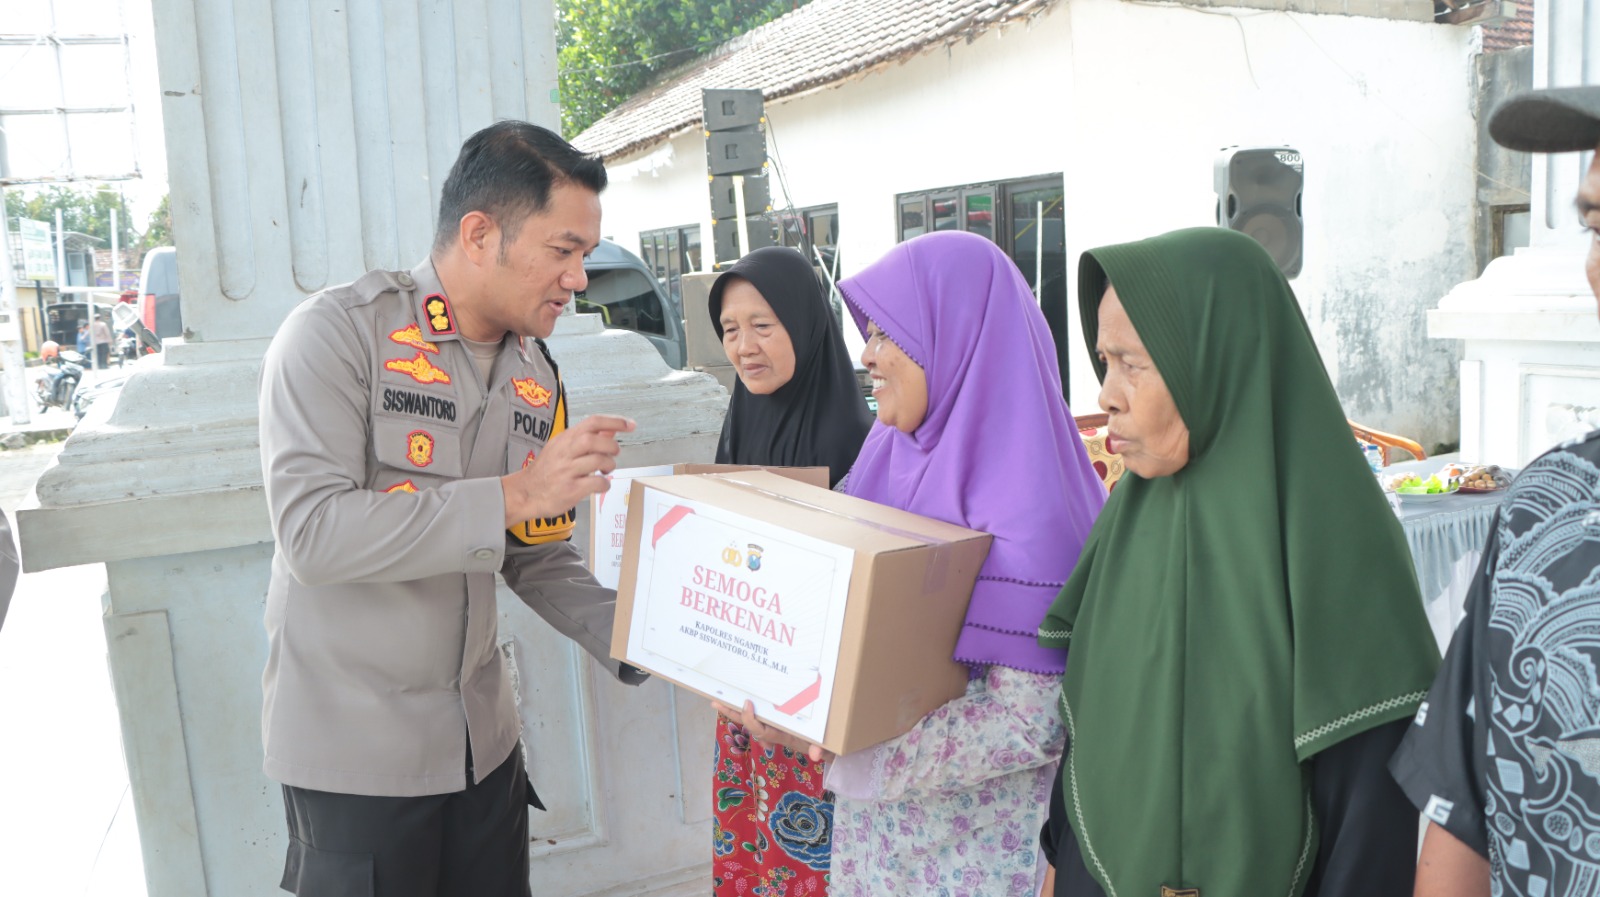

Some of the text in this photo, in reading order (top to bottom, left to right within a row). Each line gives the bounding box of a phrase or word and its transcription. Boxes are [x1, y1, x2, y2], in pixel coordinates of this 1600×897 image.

[383, 388, 456, 422] SISWANTORO
[513, 411, 550, 441] POLRI
[692, 564, 782, 616] SEMOGA
[679, 585, 797, 648] BERKENAN
[679, 625, 699, 640] AKBP
[699, 633, 750, 660] SISWANTORO,
[695, 620, 769, 657] KAPOLRES NGANJUK
